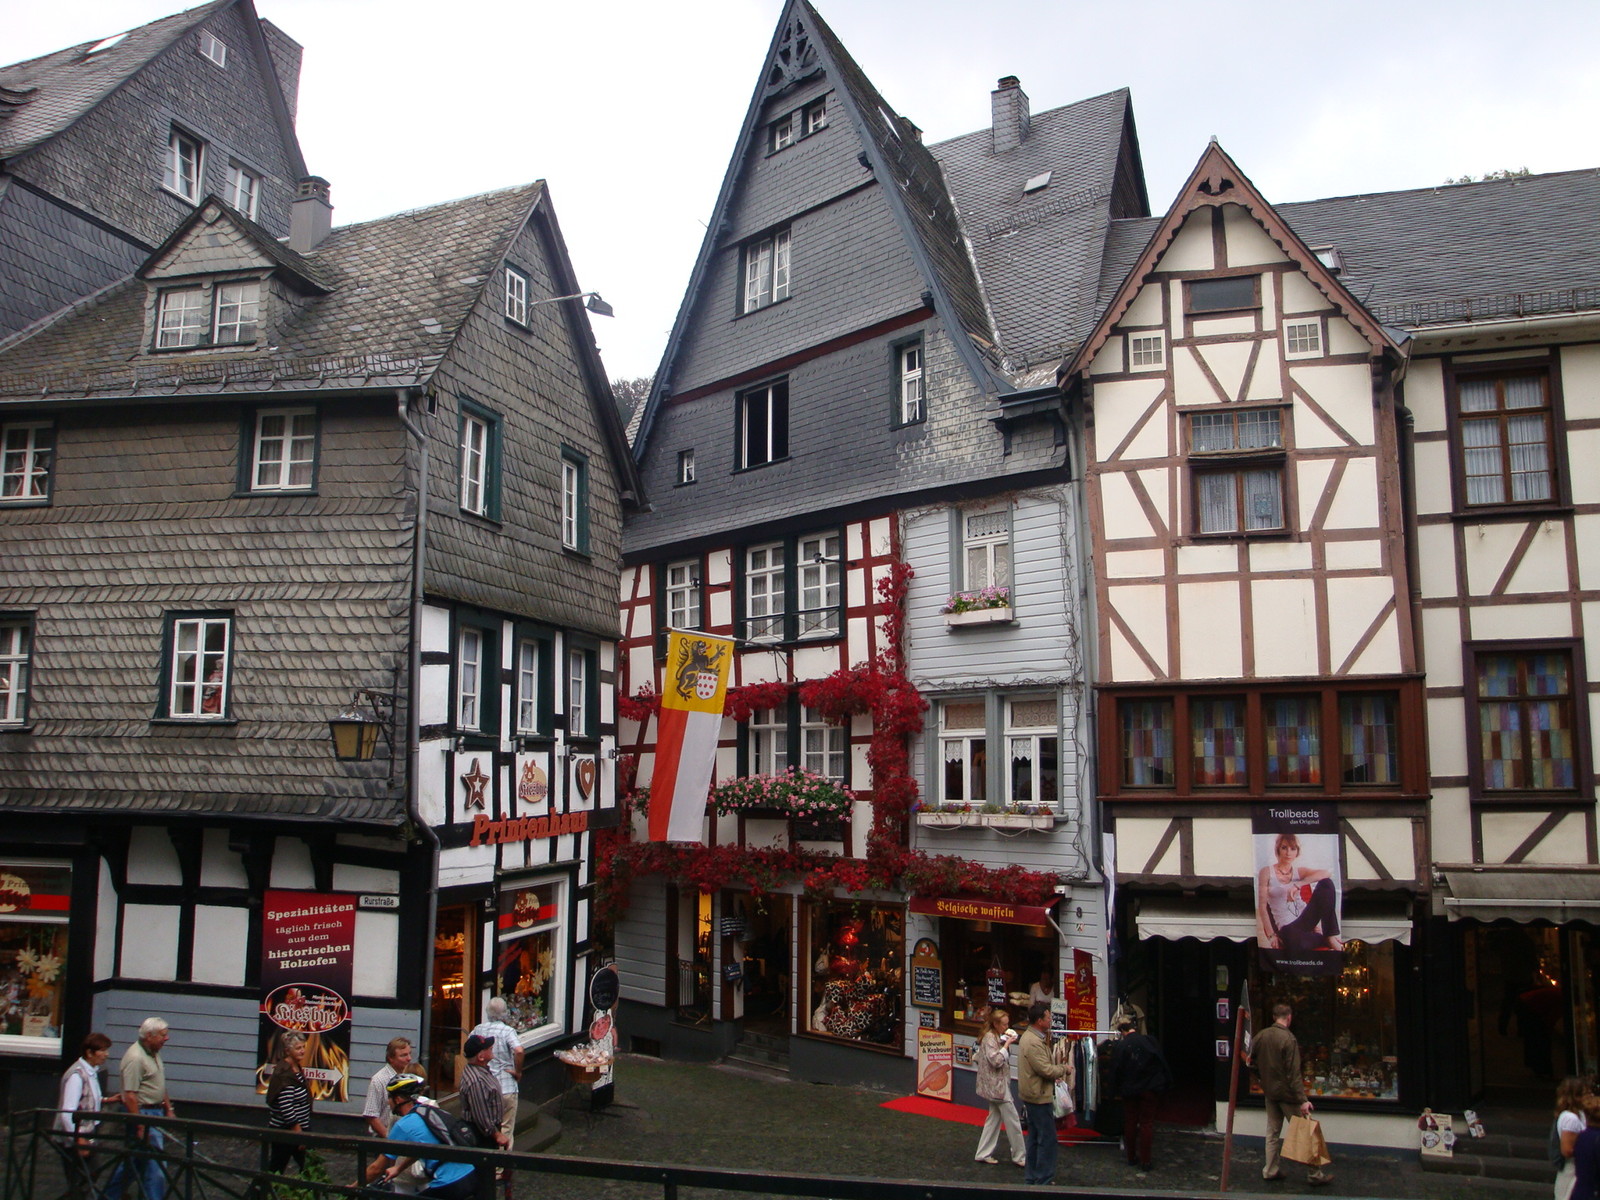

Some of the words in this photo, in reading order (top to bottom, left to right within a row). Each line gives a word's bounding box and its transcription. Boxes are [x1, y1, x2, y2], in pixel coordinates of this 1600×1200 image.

[1269, 809, 1319, 818] Trollbeads
[470, 807, 588, 847] Printenhaus
[364, 897, 394, 906] Rurstraße
[267, 903, 354, 921] Spezialitäten
[937, 901, 978, 915] Belgische
[981, 906, 1014, 919] waffeln
[1076, 907, 1082, 918] 8
[276, 924, 310, 935] täglich
[313, 921, 343, 933] frisch
[308, 933, 329, 942] dem
[268, 943, 351, 959] historischen
[280, 956, 337, 969] Holzofen
[275, 1003, 338, 1028] Kiesbye
